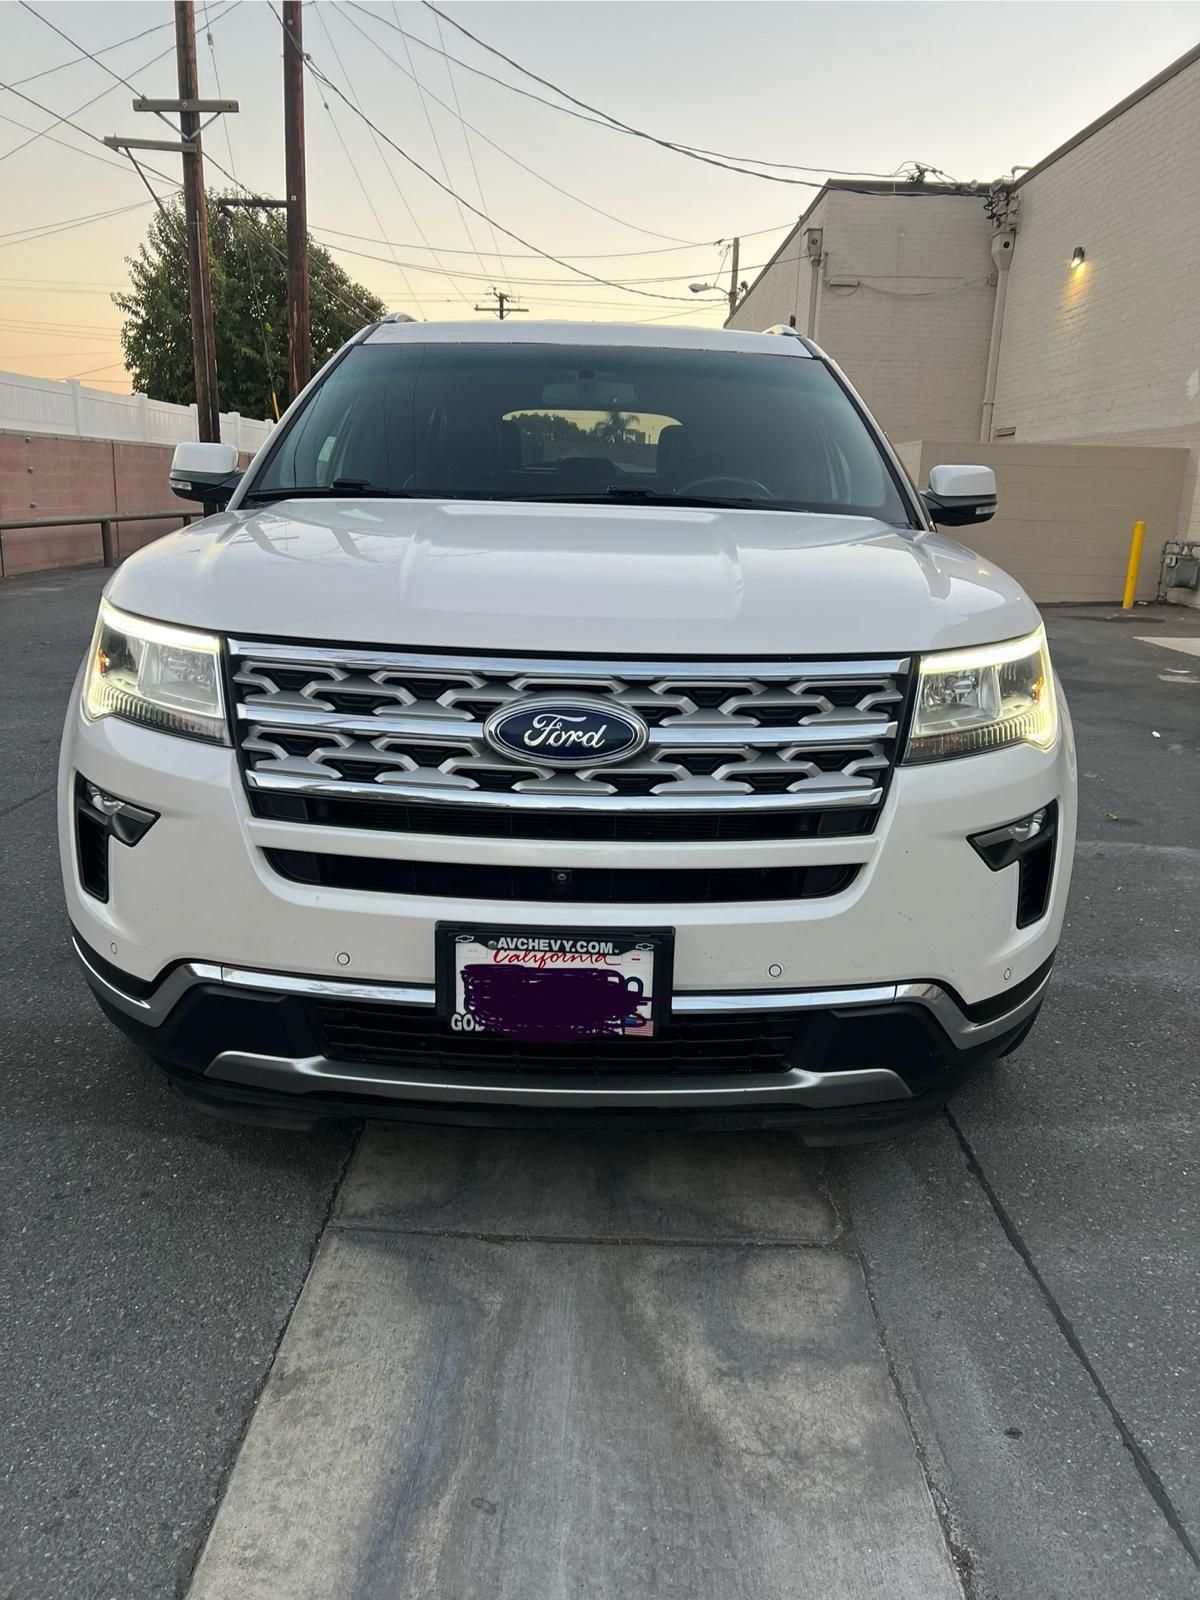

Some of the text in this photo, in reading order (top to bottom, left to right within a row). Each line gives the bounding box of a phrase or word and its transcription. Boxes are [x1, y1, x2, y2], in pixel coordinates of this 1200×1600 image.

[523, 713, 608, 749] Ford
[497, 937, 613, 954] AVCHEVY.COM
[493, 949, 621, 968] California
